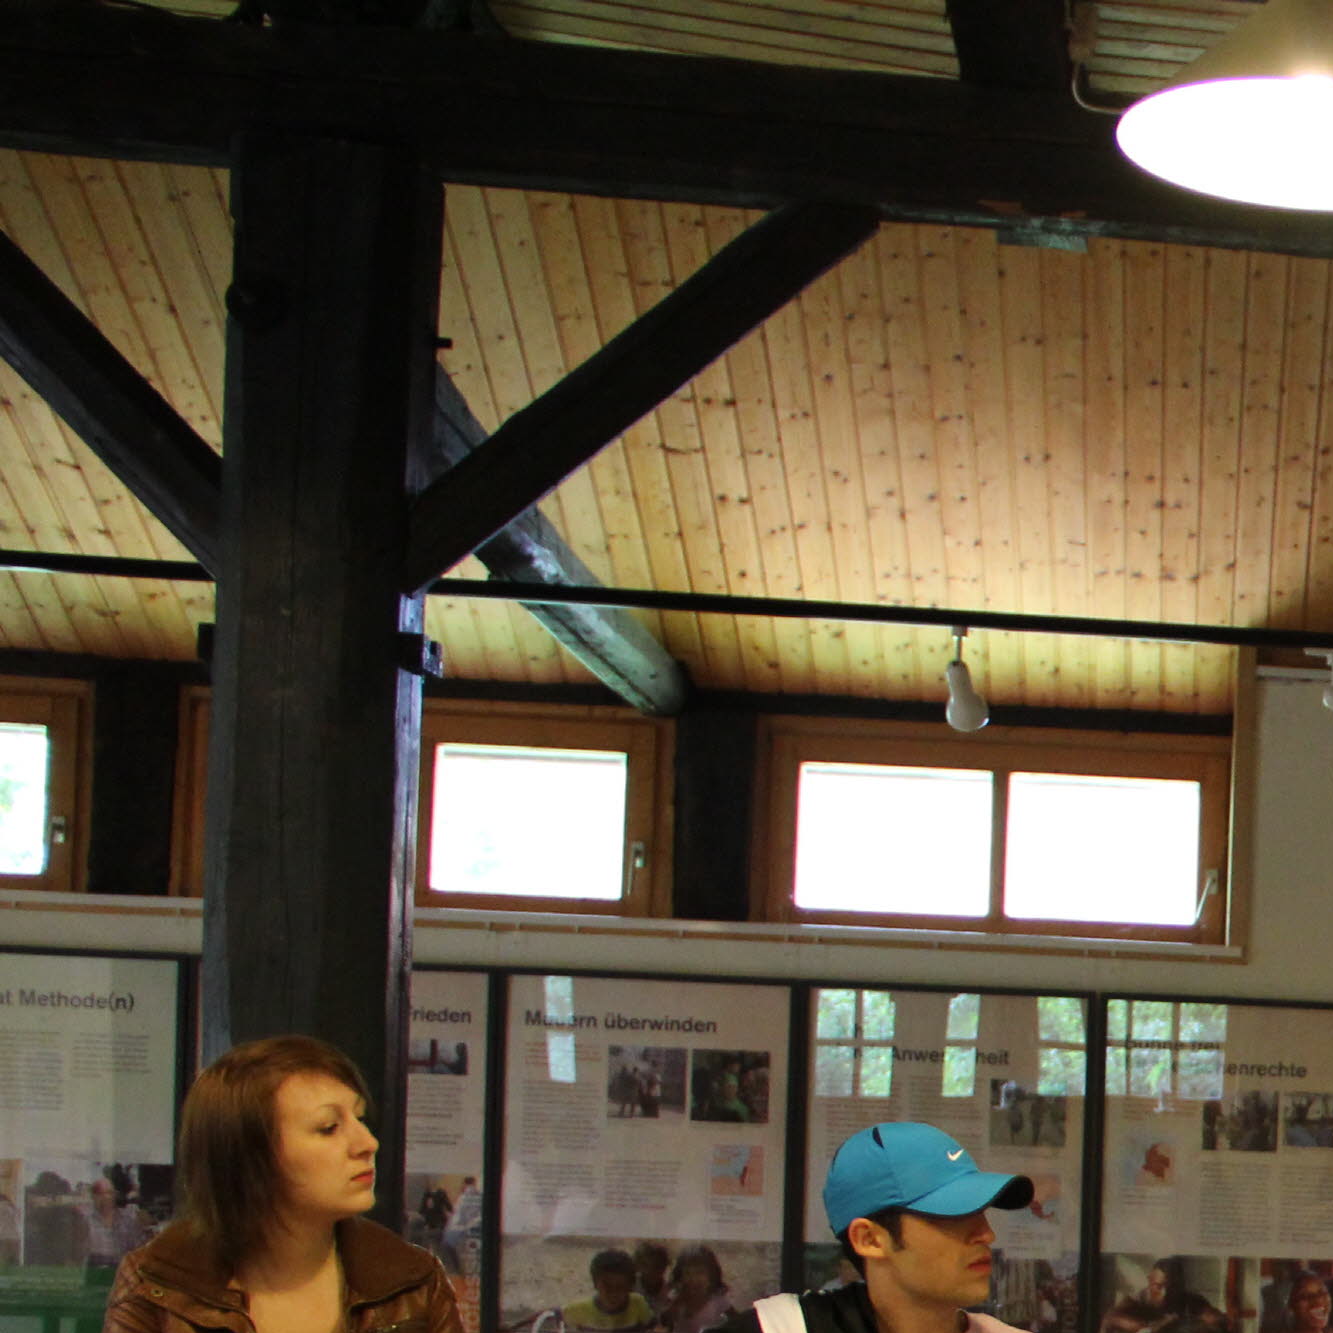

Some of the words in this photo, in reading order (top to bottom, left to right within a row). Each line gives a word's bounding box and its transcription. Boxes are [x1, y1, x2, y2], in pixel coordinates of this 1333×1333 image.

[20, 989, 135, 1012] Methode(n)
[411, 1007, 471, 1024] rieden
[604, 1012, 717, 1034] überwinden
